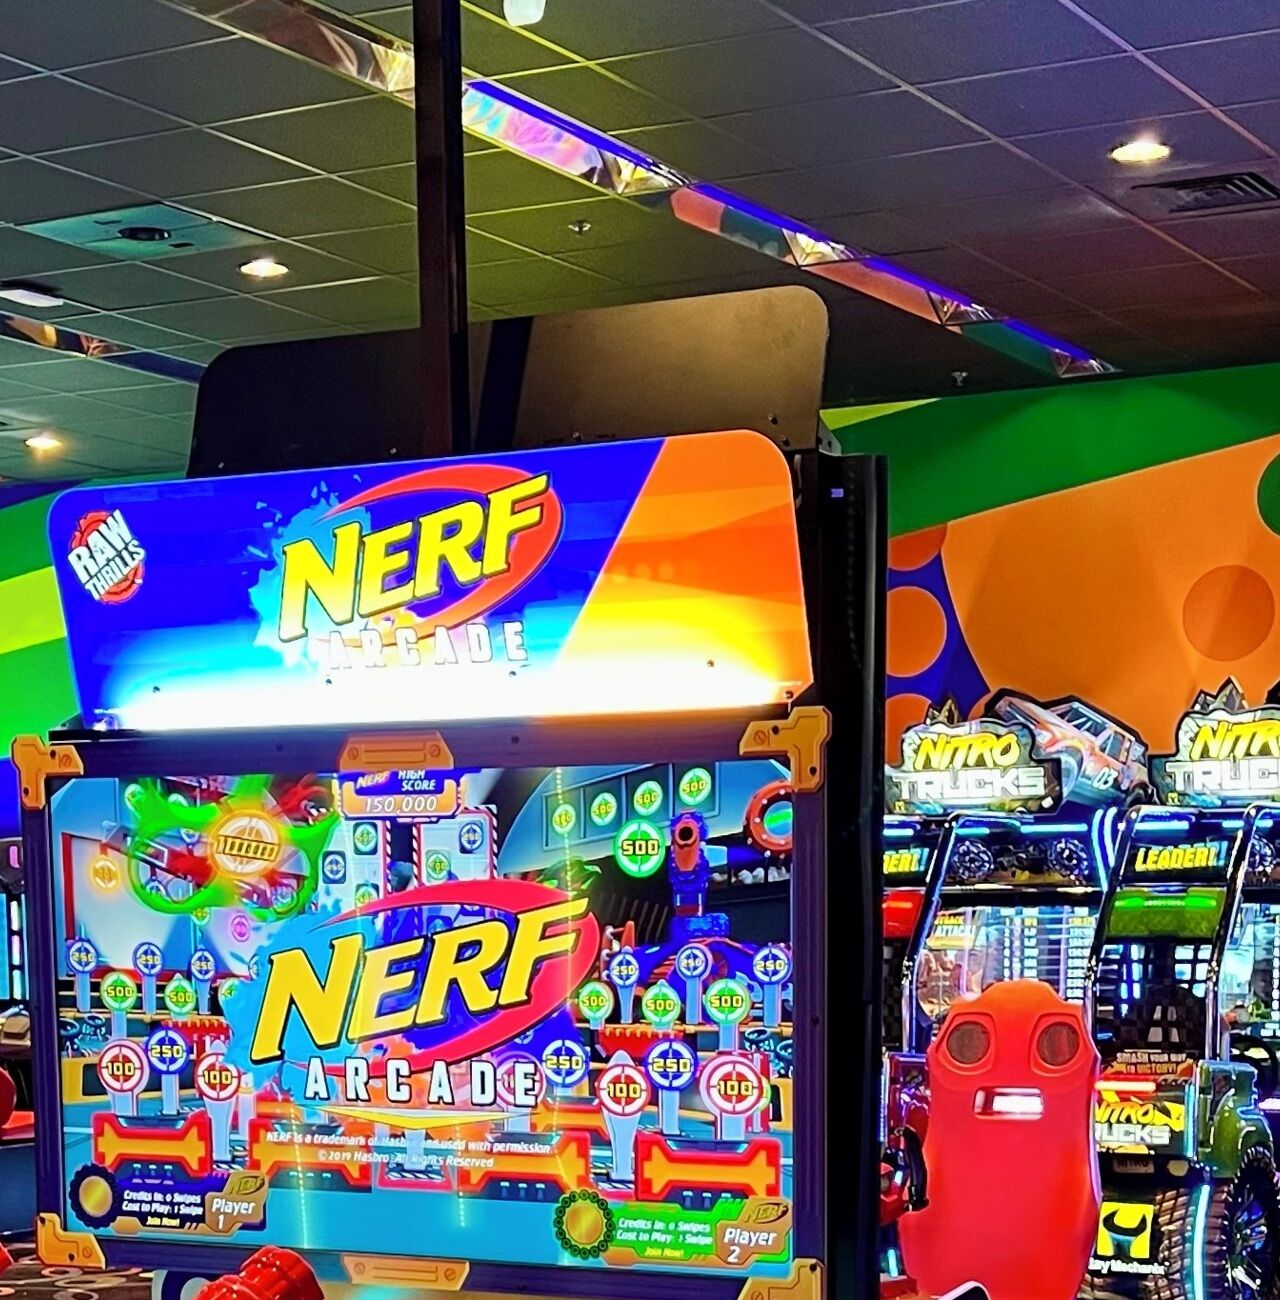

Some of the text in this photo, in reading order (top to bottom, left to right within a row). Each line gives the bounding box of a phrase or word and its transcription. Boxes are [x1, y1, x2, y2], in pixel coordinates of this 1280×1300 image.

[68, 509, 132, 583] RAW
[279, 472, 549, 643] NERF
[85, 539, 145, 600] THRILLS
[329, 621, 528, 668] ARCADE
[401, 780, 436, 791] SCORE
[893, 767, 1045, 800] TRUCKS
[366, 797, 437, 813] 150,000
[621, 840, 660, 855] 500
[613, 964, 635, 976] 250
[756, 959, 785, 971] 250
[250, 897, 589, 1062] NERF
[107, 986, 133, 997] 500
[169, 992, 193, 1003] 500
[583, 995, 606, 1007] 500
[646, 999, 675, 1011] 500
[710, 994, 742, 1007] 500
[151, 1044, 183, 1058] 250
[106, 1062, 134, 1076] 100
[546, 1057, 583, 1071] 250
[652, 1058, 690, 1073] 250
[203, 1071, 230, 1085] 100
[304, 1056, 538, 1107] ARCADE
[607, 1084, 641, 1099] 100
[719, 1080, 753, 1096] 100
[266, 1132, 291, 1142] NERF
[313, 1133, 365, 1145] trademark
[468, 1141, 490, 1151] with
[445, 1155, 493, 1168] Reserved
[230, 1176, 263, 1194] NERF
[124, 1190, 152, 1201] Credits
[122, 1201, 140, 1212] Cost
[141, 1203, 150, 1213] to
[211, 1198, 256, 1215] Player
[744, 1203, 789, 1224] NERF
[218, 1215, 225, 1229] 1
[618, 1218, 652, 1230] Credits
[677, 1221, 710, 1232] Swipes
[616, 1230, 637, 1241] Cost
[638, 1232, 649, 1241] to
[684, 1234, 714, 1246] Swipe
[724, 1228, 778, 1247] Player
[727, 1246, 741, 1263] 2
